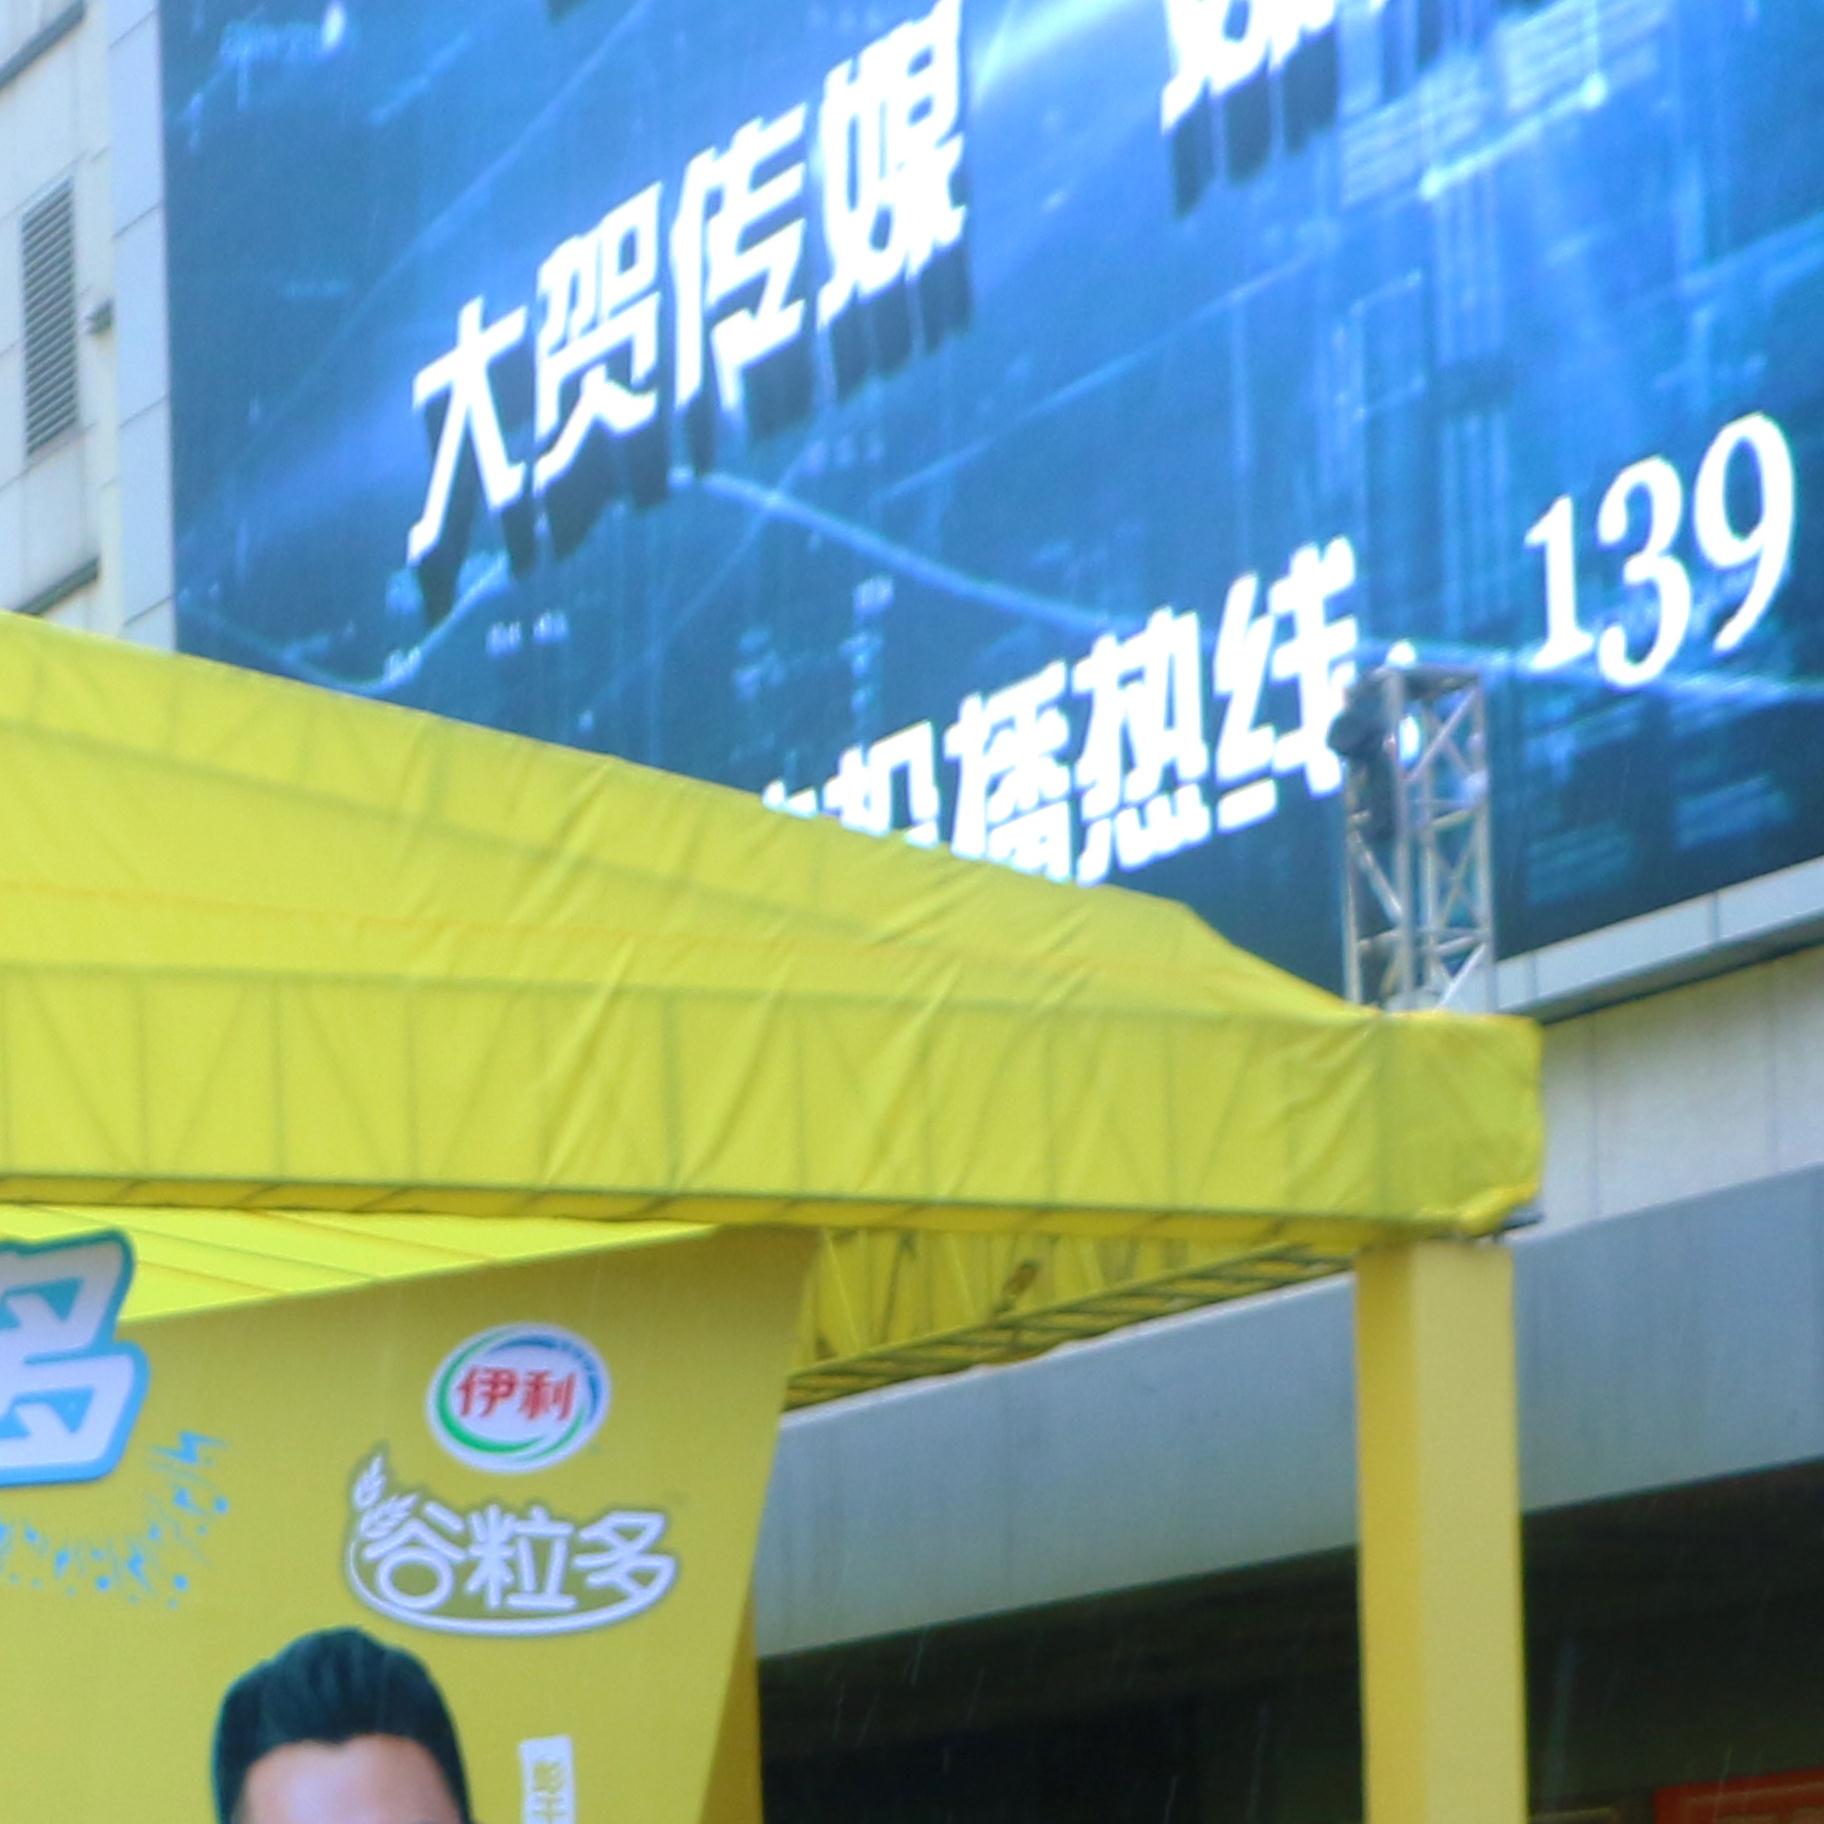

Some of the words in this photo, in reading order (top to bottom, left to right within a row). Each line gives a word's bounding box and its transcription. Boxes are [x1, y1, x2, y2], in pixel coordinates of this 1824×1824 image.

[407, 0, 966, 566] 大贺传媒
[1523, 411, 1794, 688] 139
[457, 1364, 579, 1422] 伊利
[352, 1480, 680, 1632] 谷粒多
